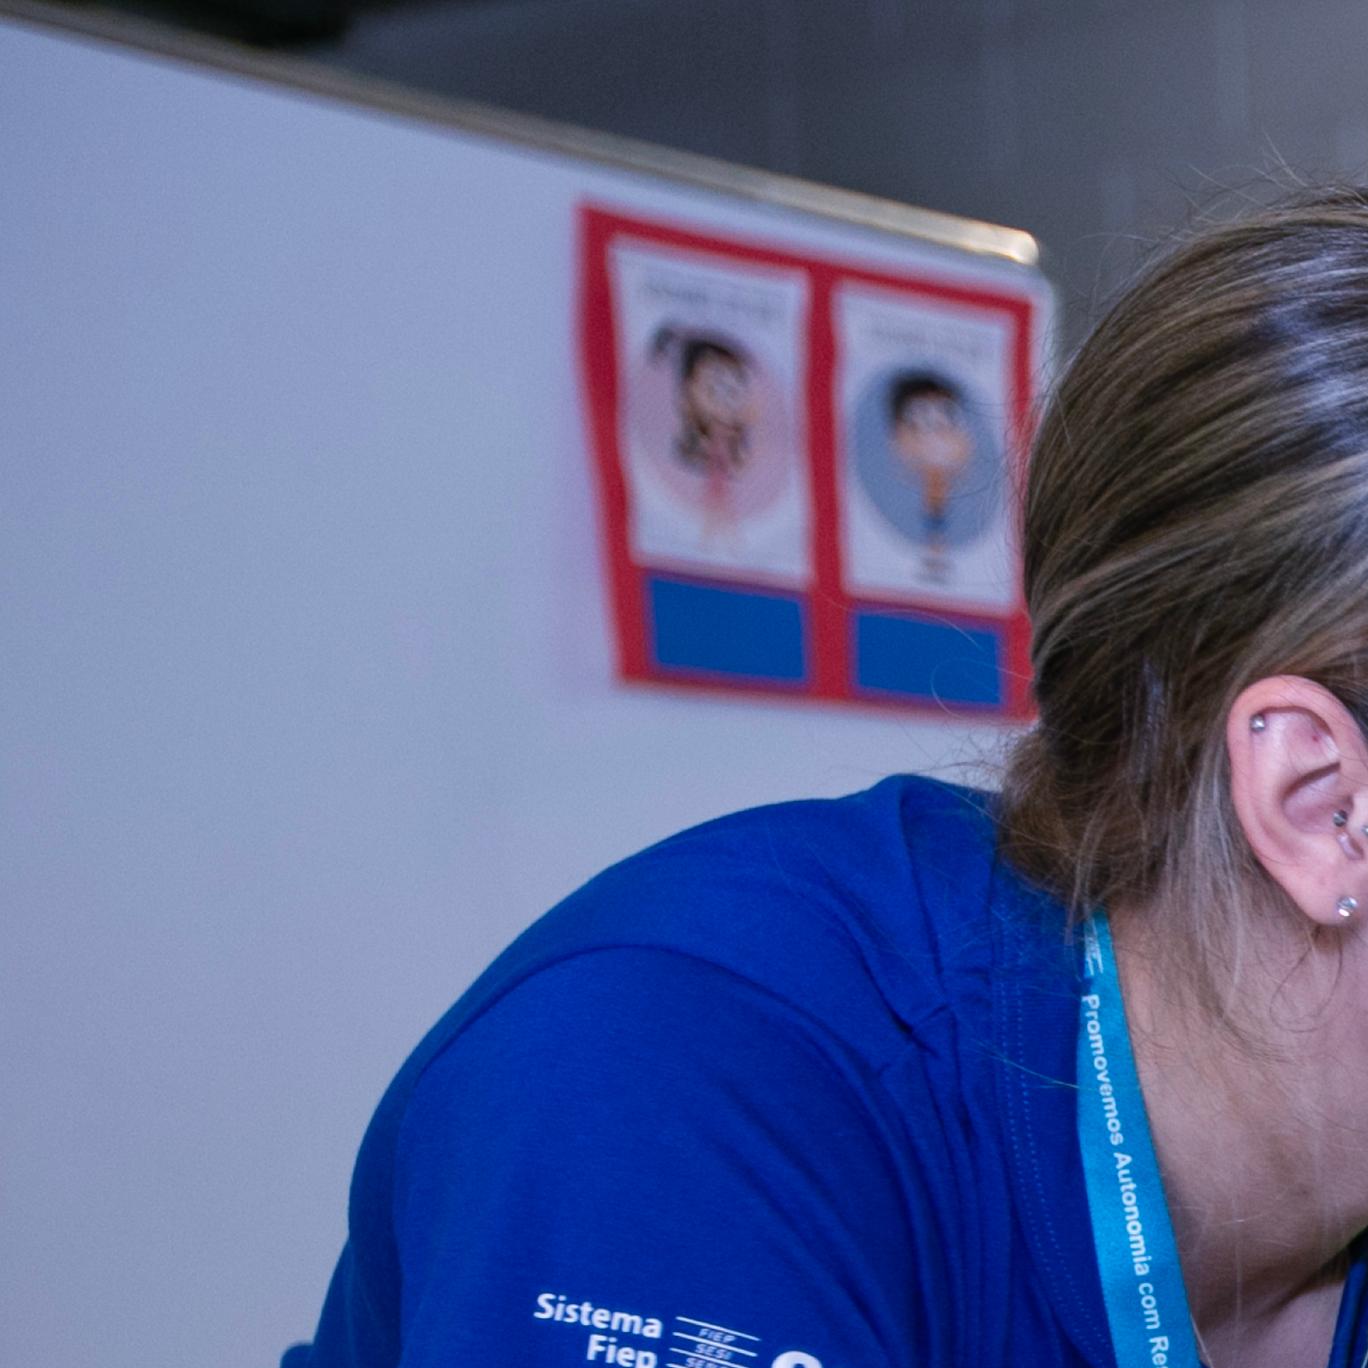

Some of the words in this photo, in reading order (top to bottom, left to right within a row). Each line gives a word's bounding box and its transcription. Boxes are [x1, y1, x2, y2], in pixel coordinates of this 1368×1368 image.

[1081, 994, 1124, 1146] Promovemos
[1113, 1152, 1152, 1276] Autonomia
[1138, 1282, 1160, 1330] com
[533, 1293, 663, 1338] Sistema
